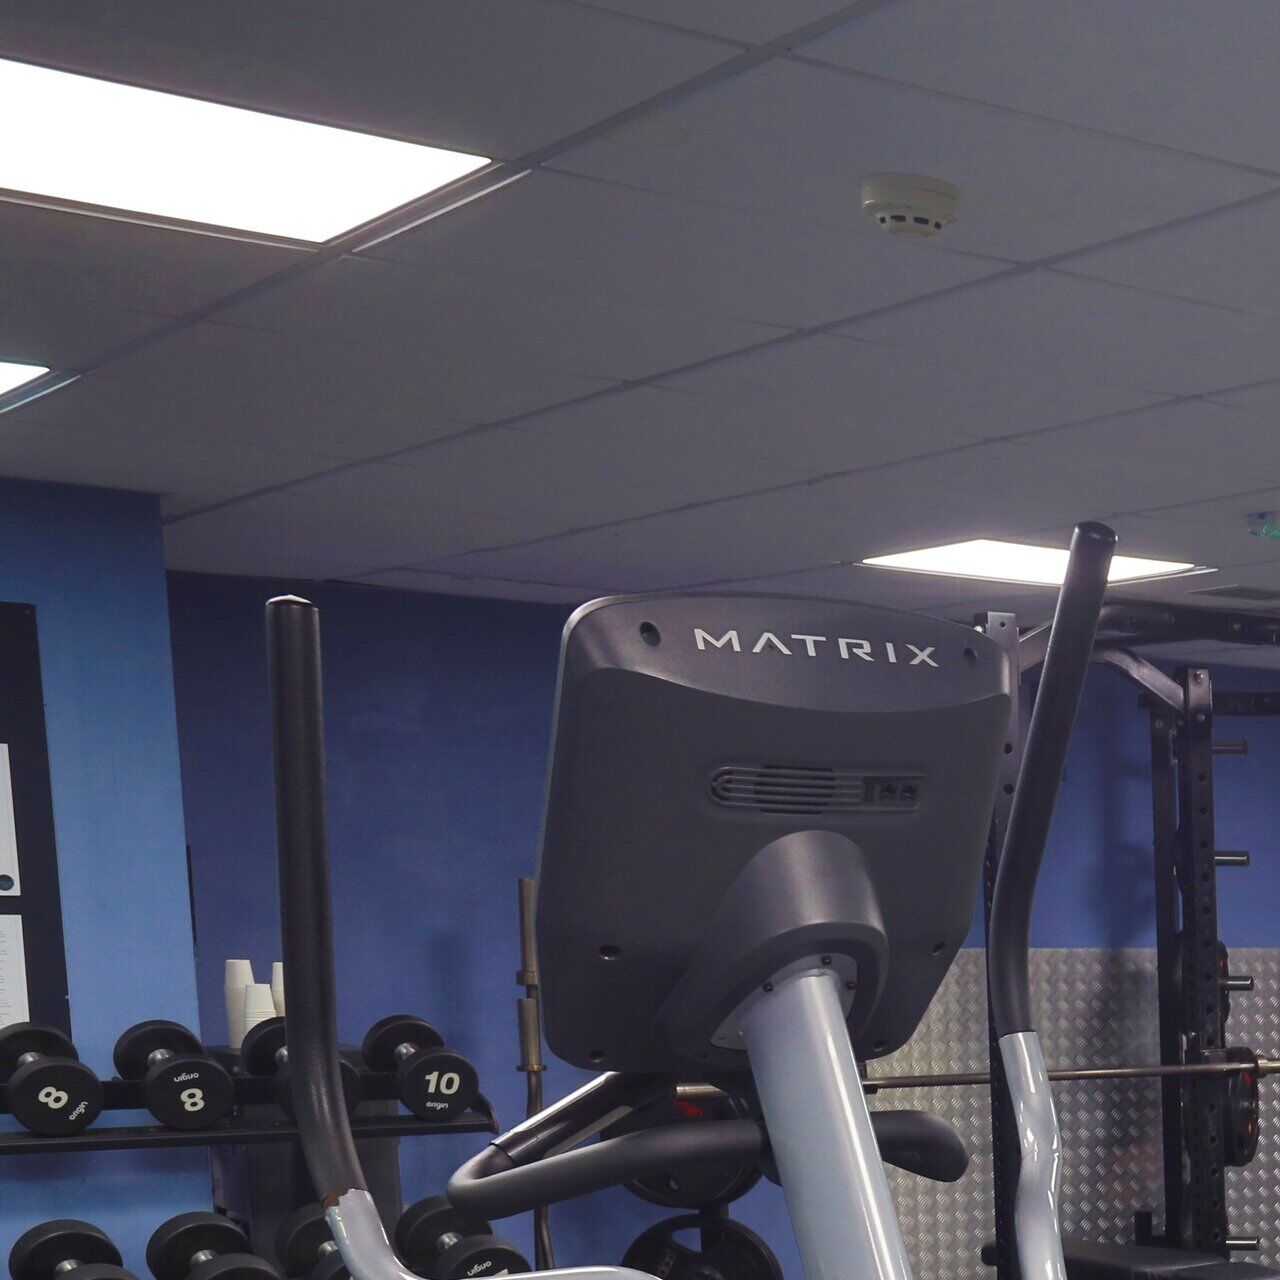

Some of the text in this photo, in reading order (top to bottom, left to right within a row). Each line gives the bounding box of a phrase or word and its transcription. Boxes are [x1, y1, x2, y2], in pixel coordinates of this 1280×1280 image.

[693, 627, 940, 668] MATRIX
[173, 1072, 200, 1083] origin
[424, 1071, 460, 1095] 10
[38, 1086, 69, 1110] 8
[180, 1088, 205, 1112] 8
[426, 1101, 449, 1110] origin
[69, 1101, 88, 1121] origin
[467, 1260, 492, 1277] origin
